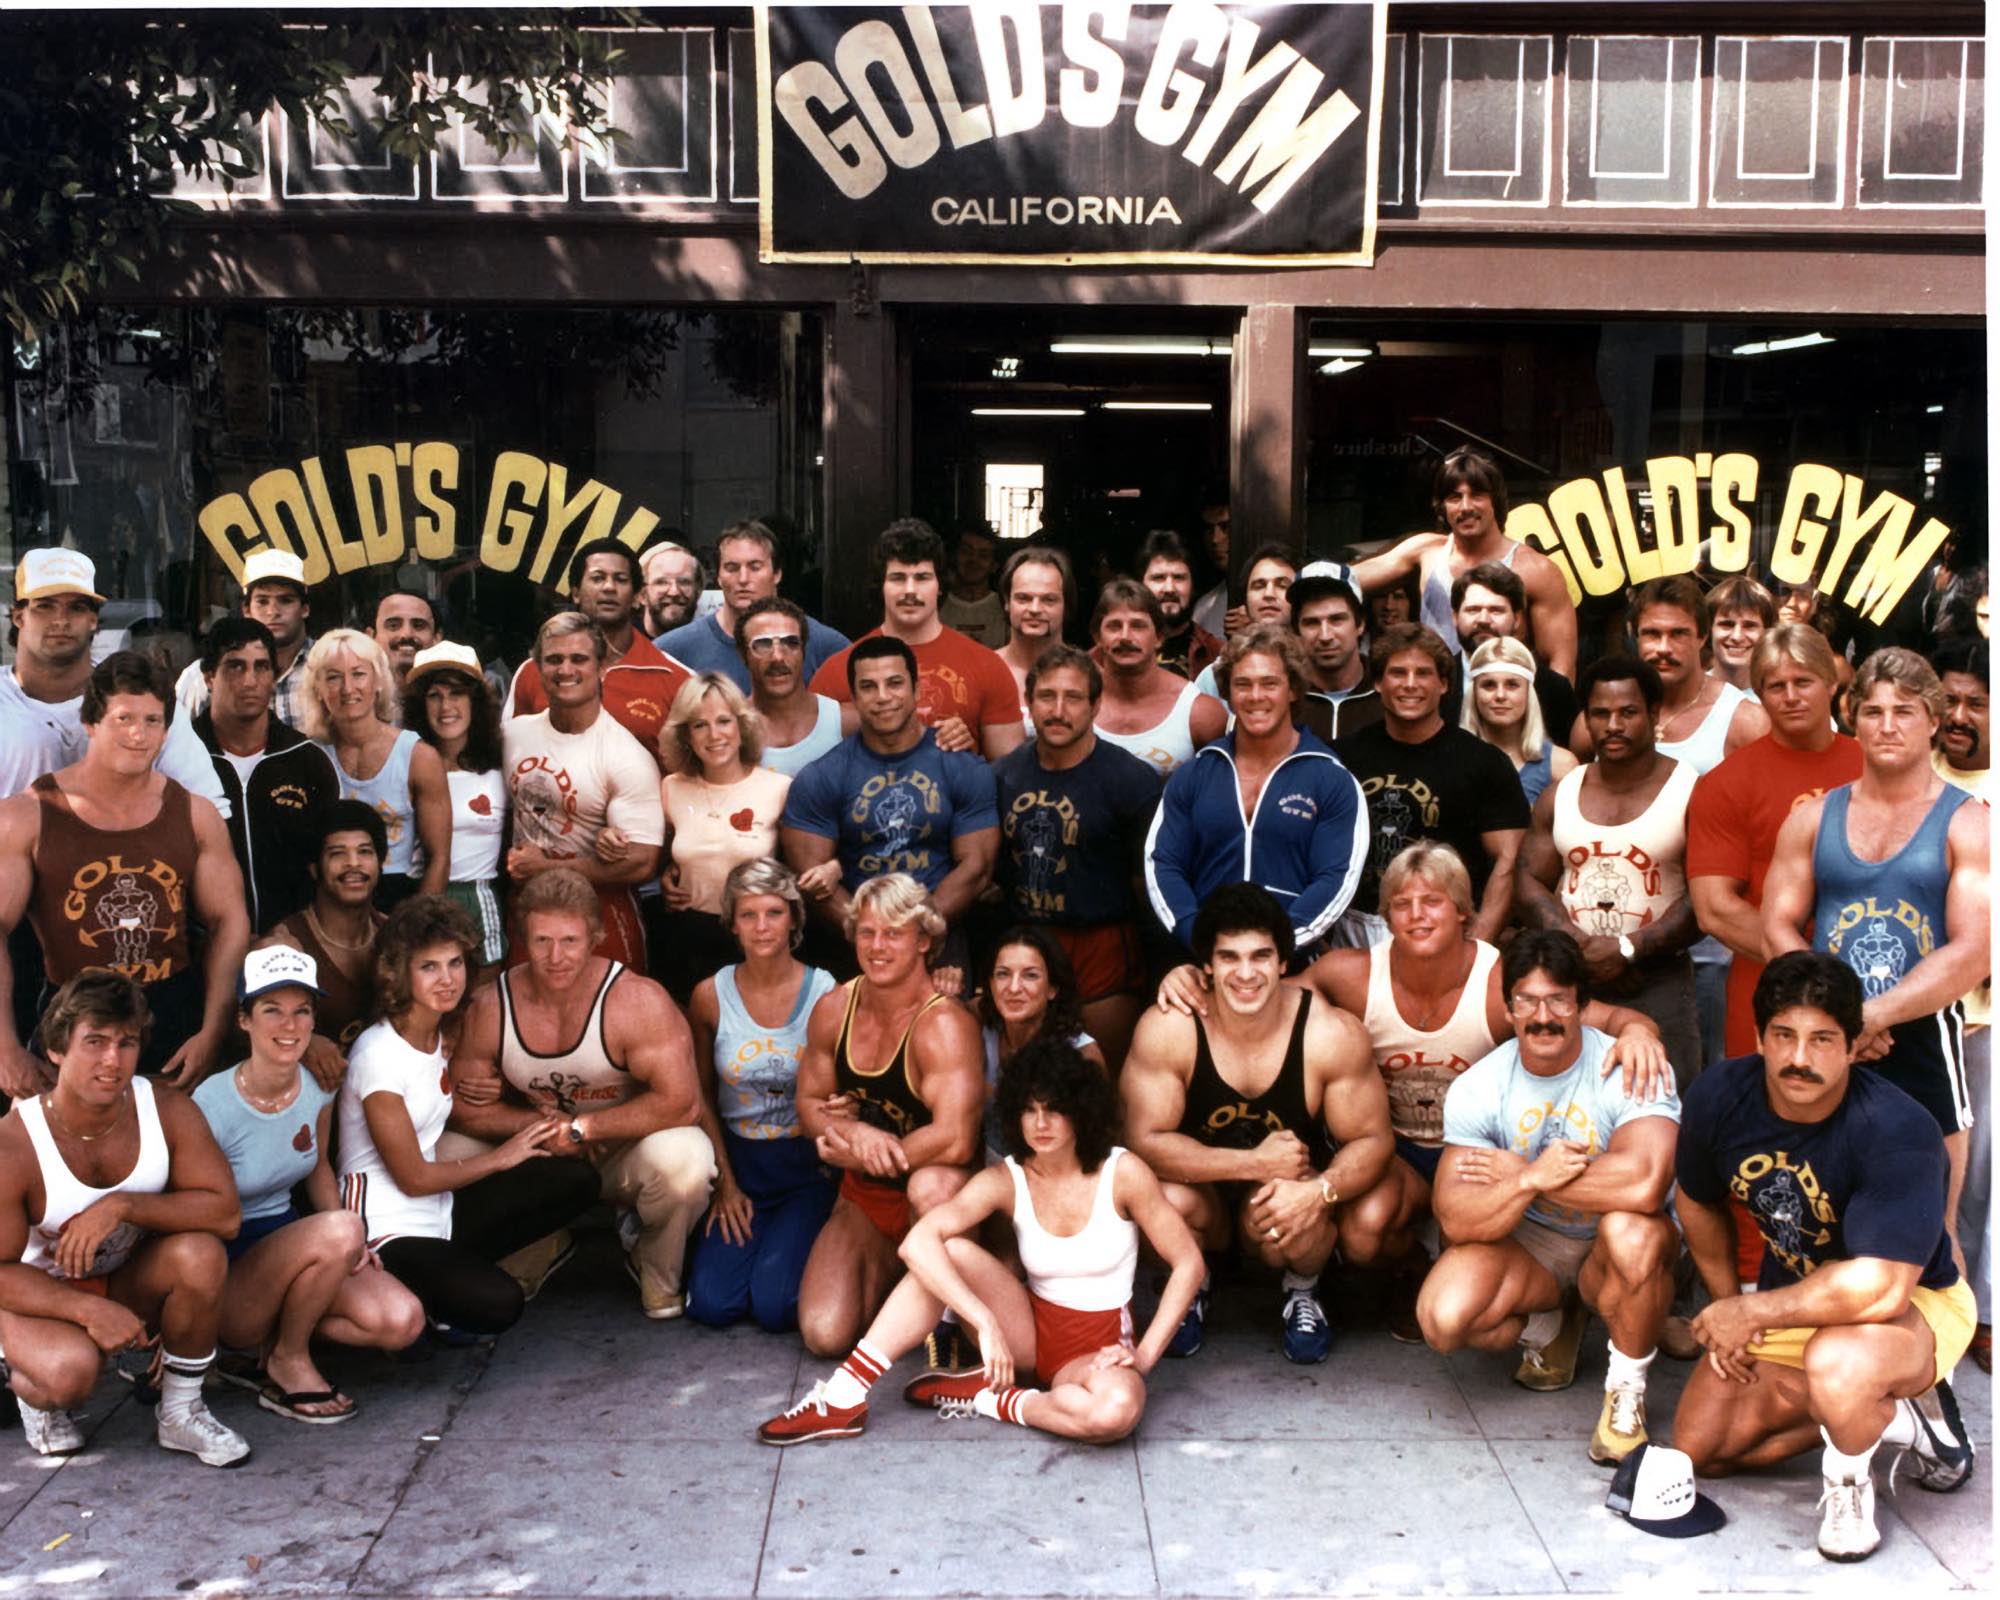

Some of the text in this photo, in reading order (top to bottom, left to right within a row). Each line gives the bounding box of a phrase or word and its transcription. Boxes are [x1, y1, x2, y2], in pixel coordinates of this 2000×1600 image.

[1135, 5, 1361, 215] GYM
[931, 196, 1183, 227] CALIFORNIA
[198, 441, 460, 587] GOLD'S
[1505, 452, 1950, 627] GOLD'S GYM
[852, 770, 942, 824] GOLD'S
[1003, 789, 1081, 847] GOLD'S
[1361, 774, 1441, 828] OLD'S
[64, 855, 184, 921] GOLD'S
[858, 850, 930, 873] GYM
[1568, 841, 1662, 897] GOLD'S
[1827, 897, 1936, 957] GOLD'S
[81, 958, 172, 983] YM
[1384, 1050, 1471, 1074] OLD
[1202, 1102, 1284, 1134] OLD
[1731, 1151, 1838, 1224] GOLD'S
